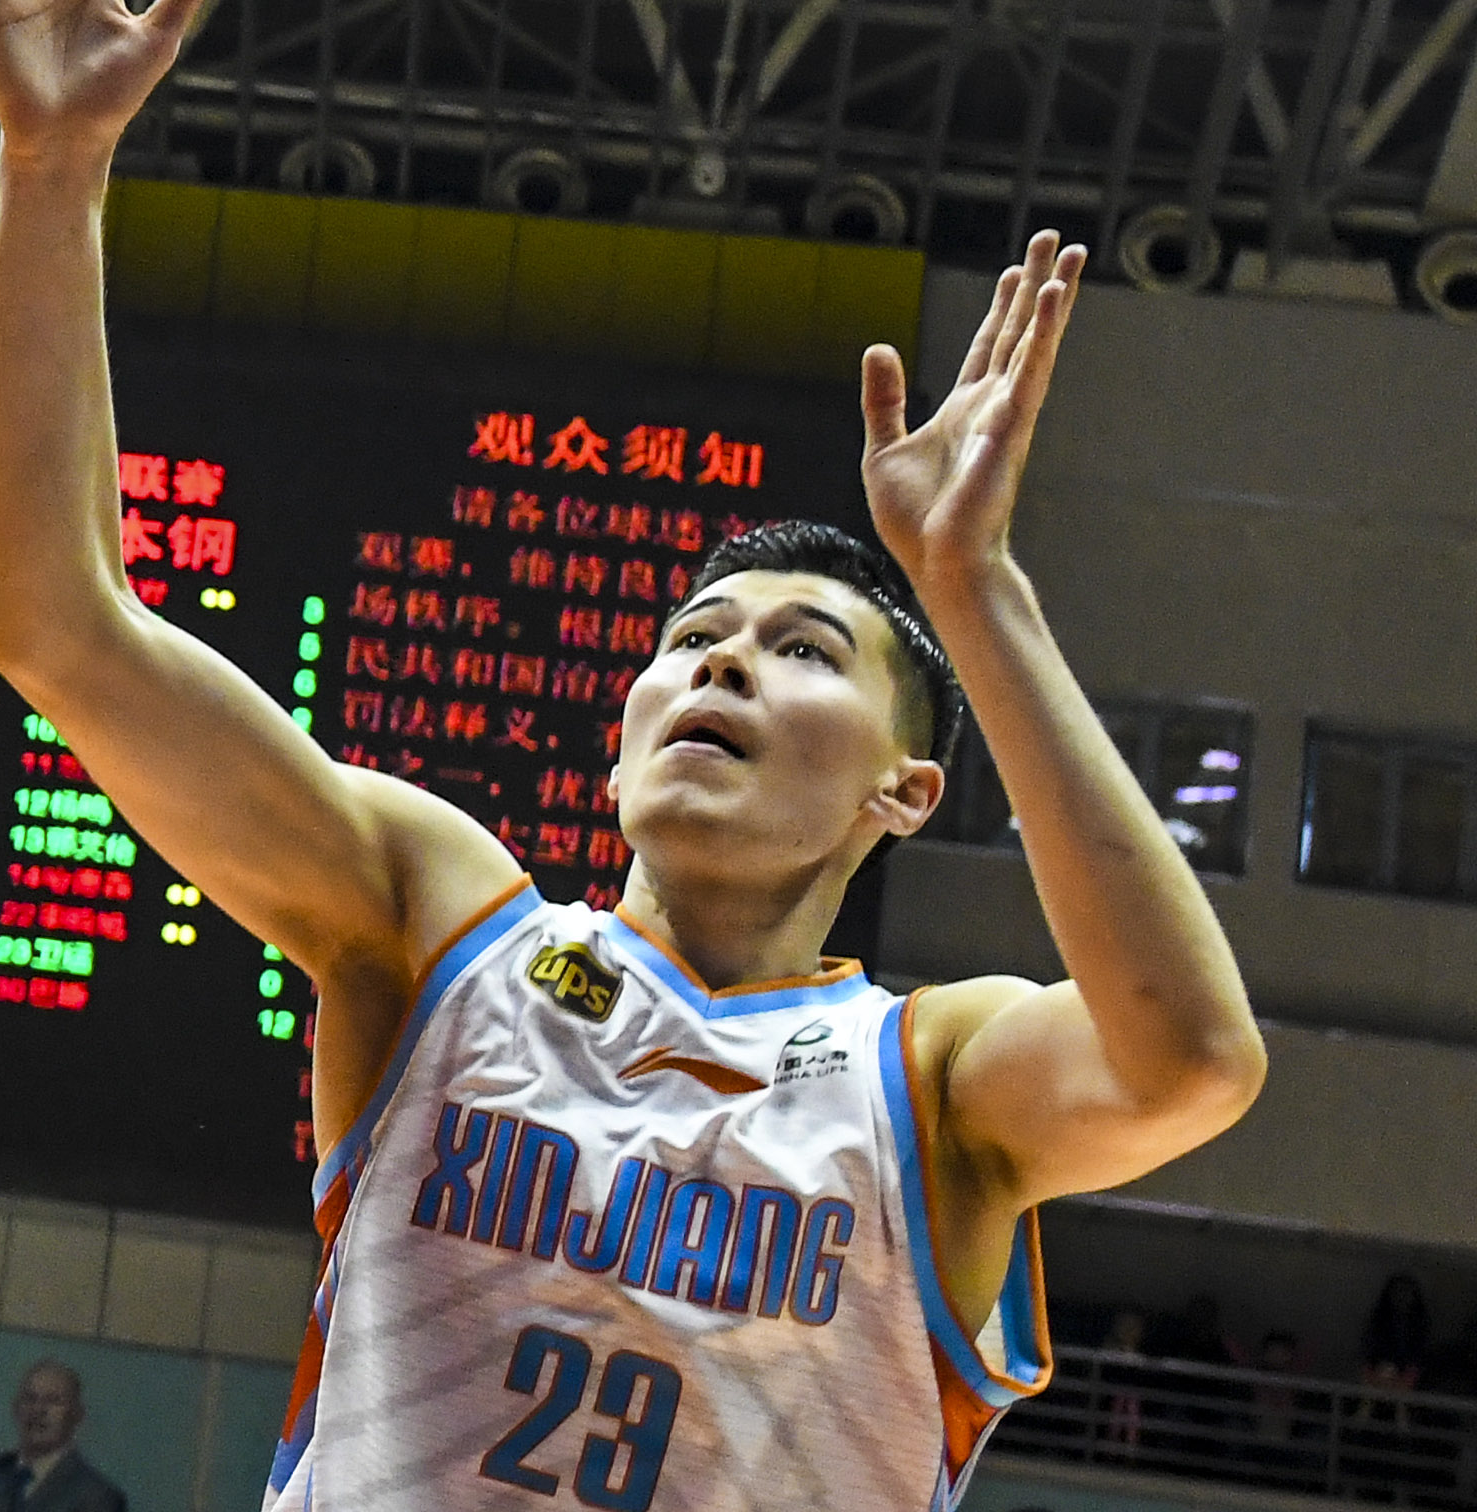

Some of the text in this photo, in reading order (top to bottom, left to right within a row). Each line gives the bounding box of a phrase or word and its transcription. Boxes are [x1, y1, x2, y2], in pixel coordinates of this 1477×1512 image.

[468, 411, 763, 487] 观众须知
[259, 968, 283, 998] 0
[530, 954, 612, 1015] ups
[411, 1102, 855, 1326] XINJIANG
[480, 1324, 683, 1511] 23
